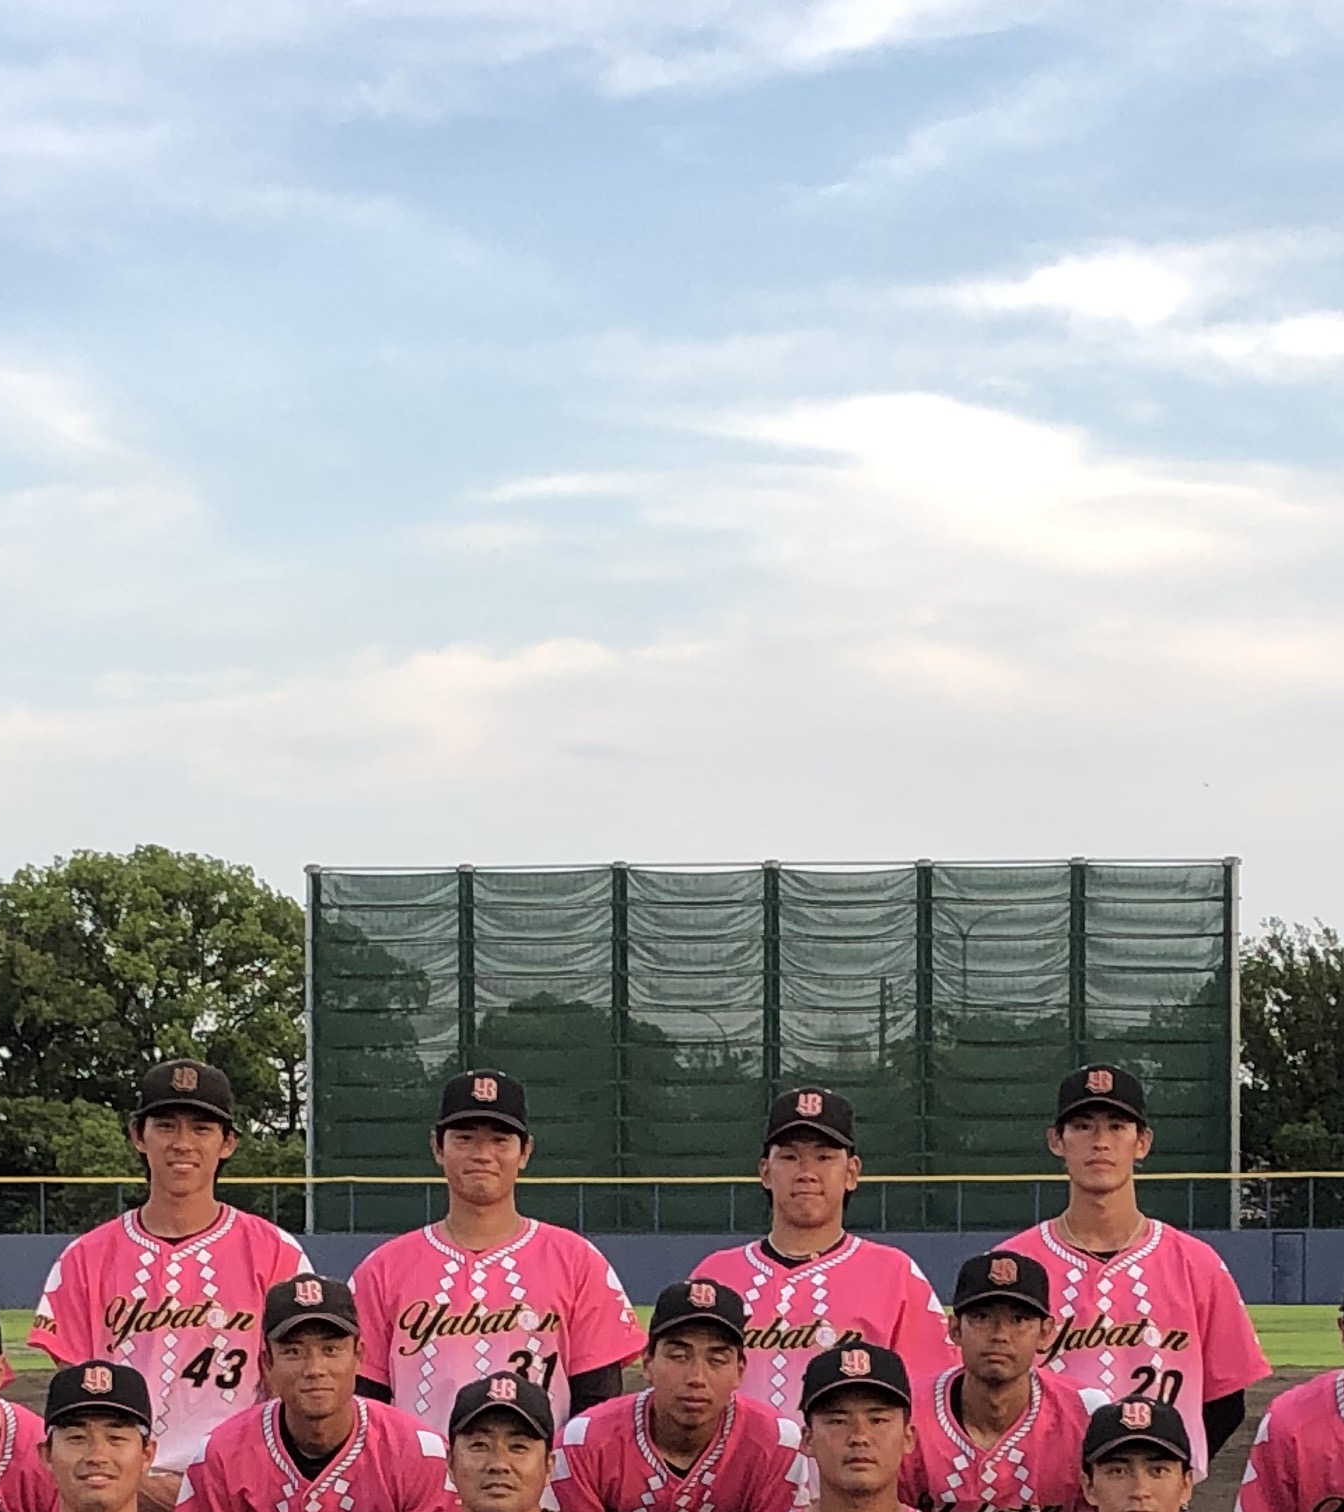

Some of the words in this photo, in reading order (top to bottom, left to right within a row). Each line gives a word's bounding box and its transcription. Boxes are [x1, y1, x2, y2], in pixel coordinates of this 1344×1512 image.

[105, 1296, 254, 1354] Yabaton
[399, 1300, 561, 1356] Yabaton
[743, 1315, 862, 1350] abaton
[181, 1347, 248, 1389] 43
